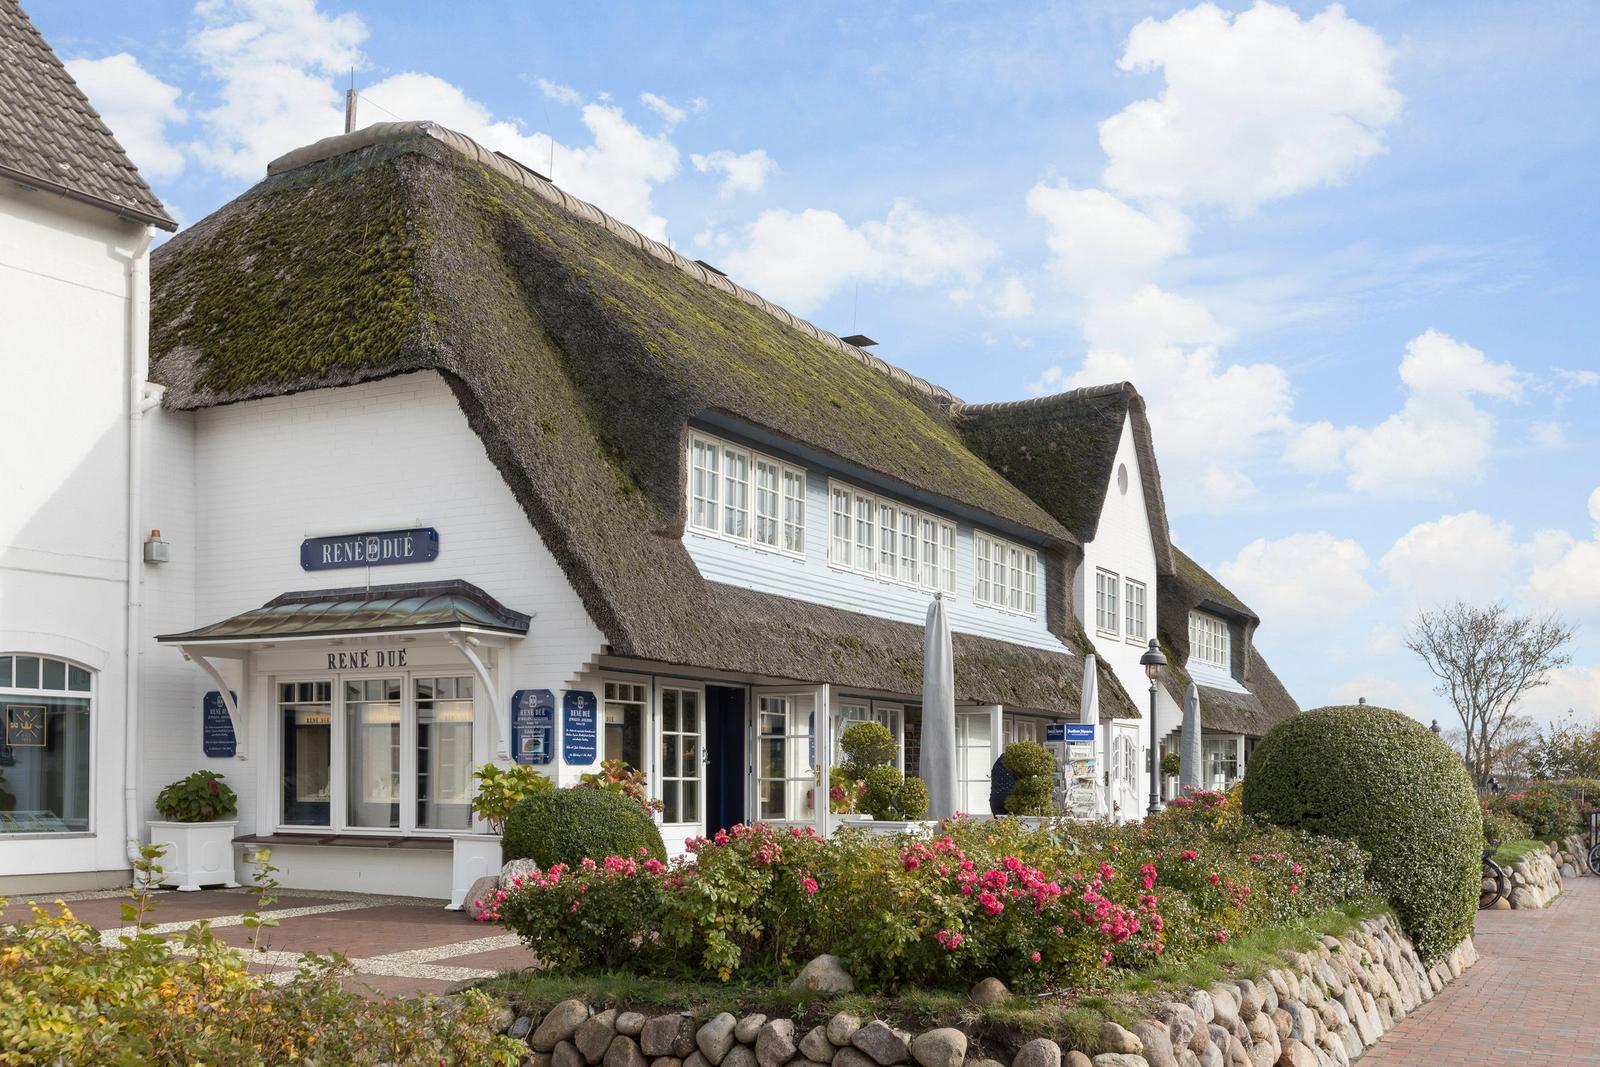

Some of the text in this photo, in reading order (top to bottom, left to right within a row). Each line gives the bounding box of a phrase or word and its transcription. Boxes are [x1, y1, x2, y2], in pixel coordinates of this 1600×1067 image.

[322, 532, 415, 563] RENÉ DUÉ
[327, 648, 407, 670] RENÉ DUÉ
